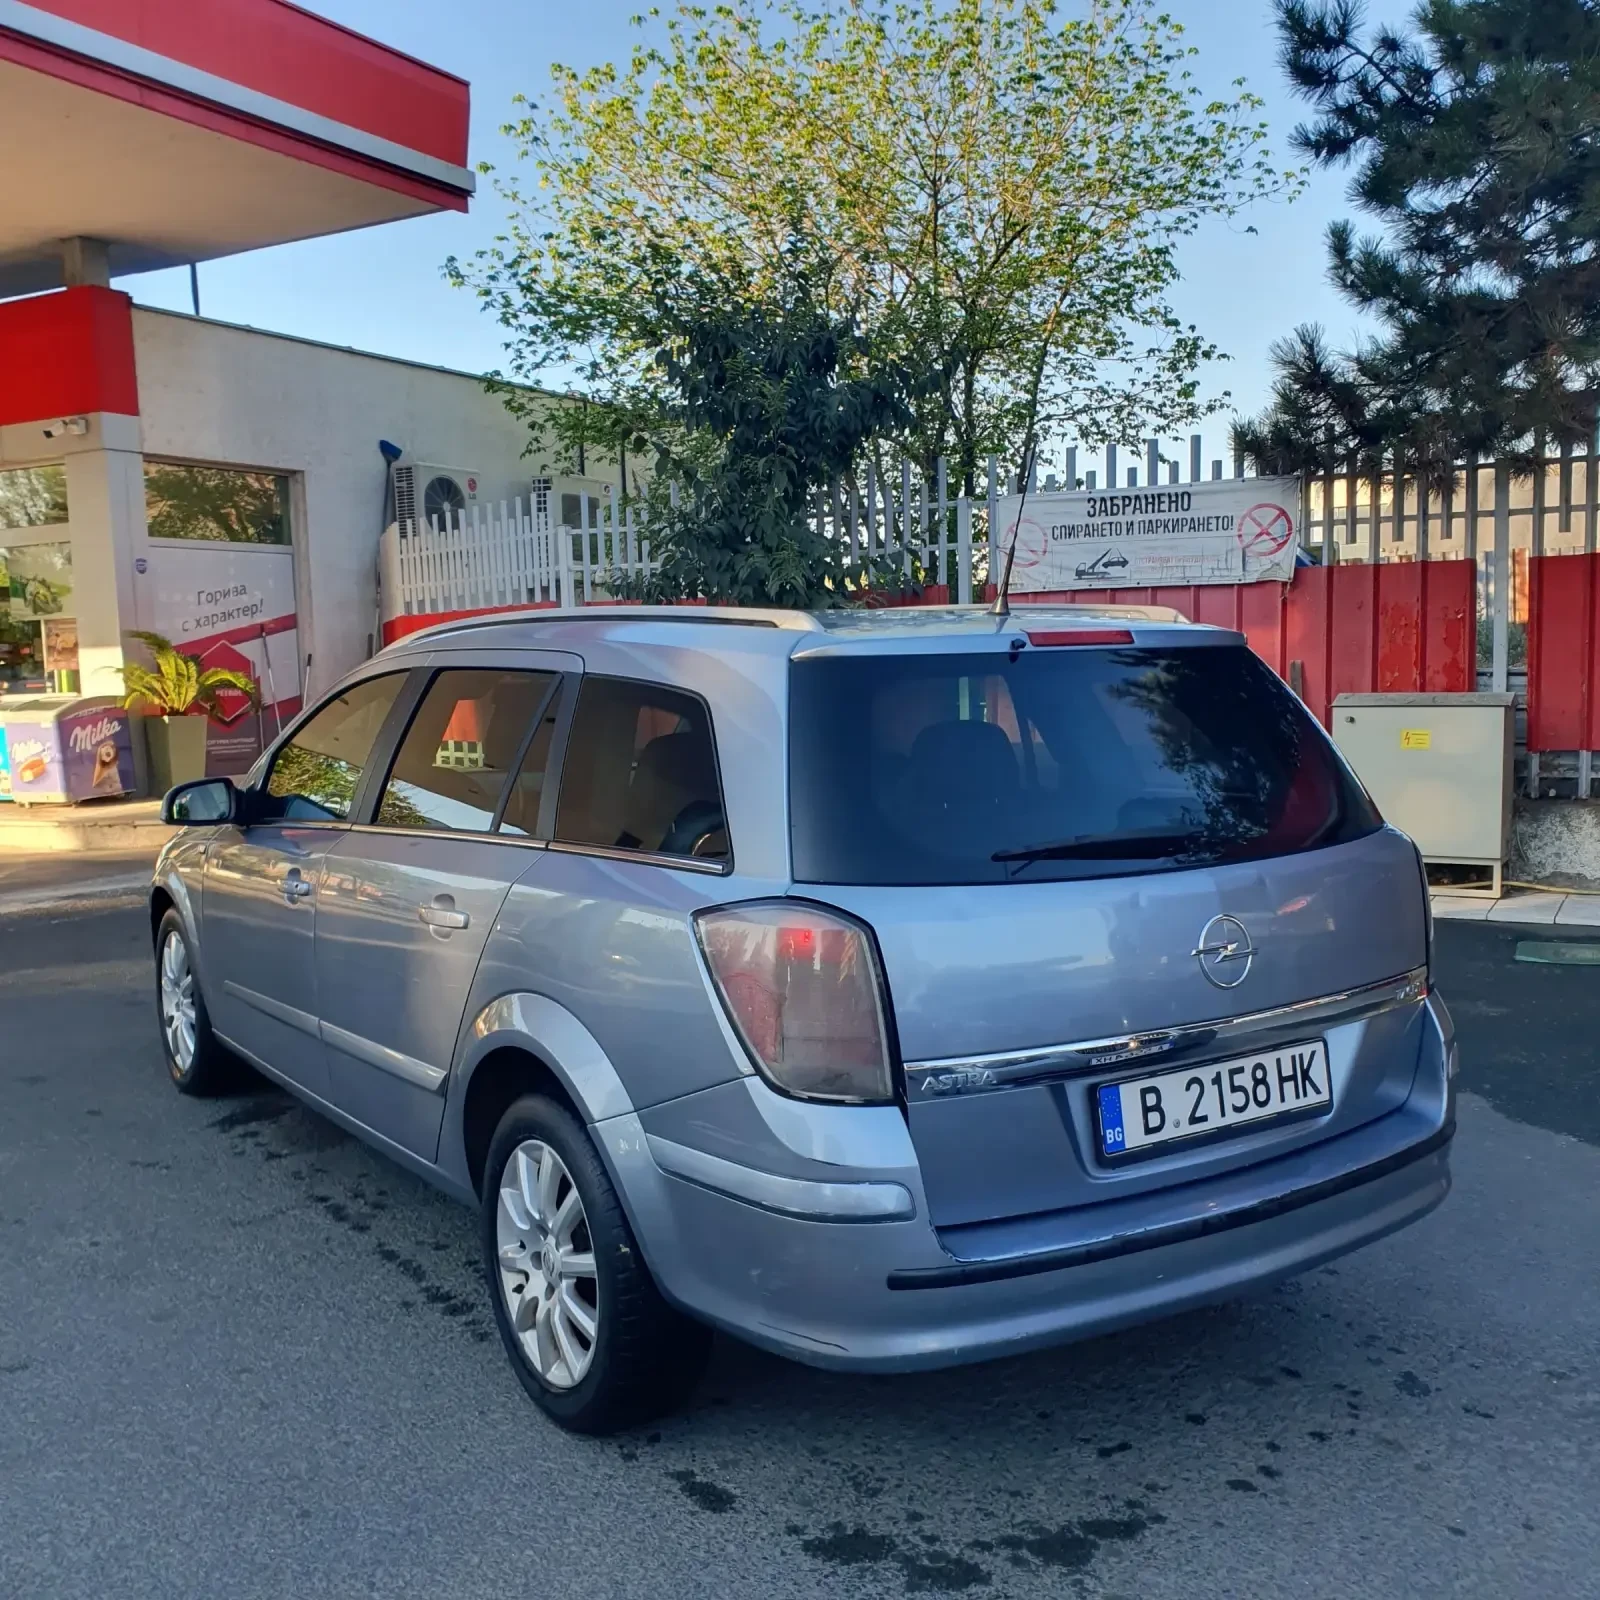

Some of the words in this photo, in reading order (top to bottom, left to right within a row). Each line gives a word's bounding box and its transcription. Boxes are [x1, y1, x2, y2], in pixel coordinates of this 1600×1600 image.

[1087, 490, 1192, 518] ЗАБРАНЕНО
[1051, 520, 1123, 541] СПИРАНЕТО
[1126, 520, 1135, 536] И
[1138, 515, 1234, 535] ПАРКИРАНЕТО!
[197, 584, 248, 606] Горива
[182, 620, 189, 632] с
[195, 598, 264, 629] характер!
[69, 717, 122, 752] Milka
[921, 1070, 998, 1091] ASTRA
[1139, 1085, 1166, 1136] B
[1185, 1062, 1271, 1126] 2158
[1276, 1050, 1322, 1104] HK
[1105, 1127, 1123, 1145] BG
